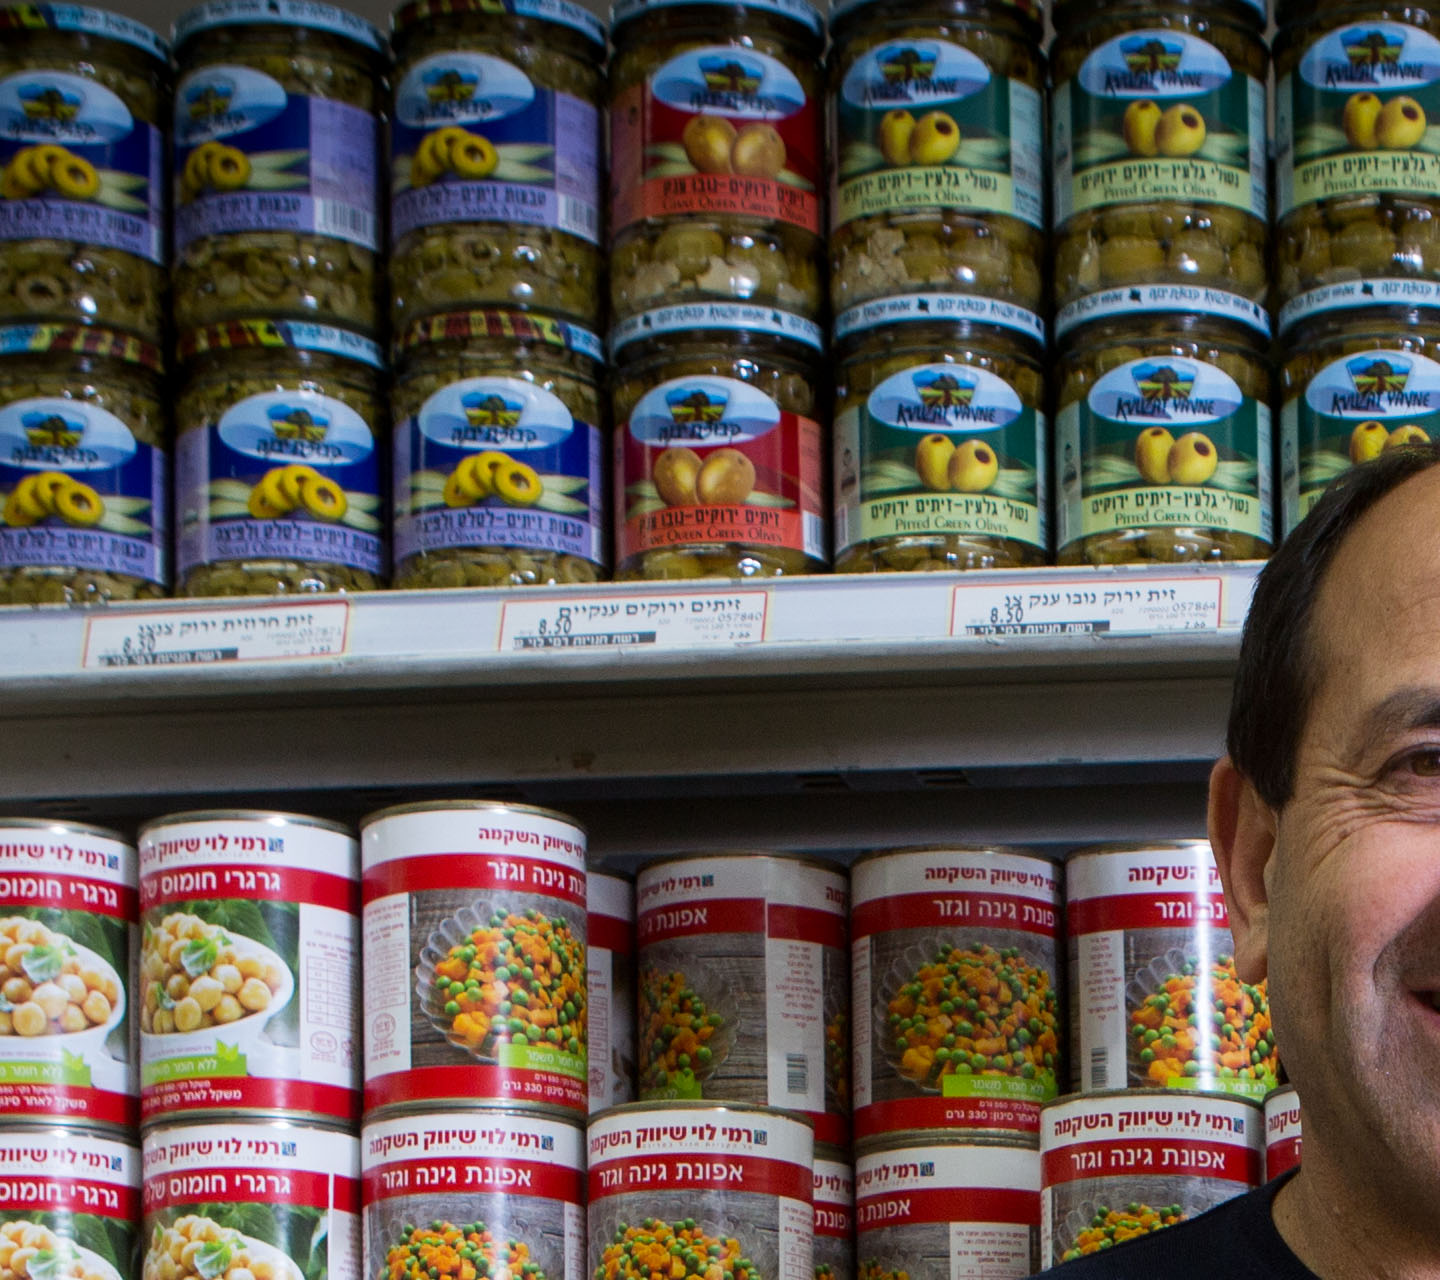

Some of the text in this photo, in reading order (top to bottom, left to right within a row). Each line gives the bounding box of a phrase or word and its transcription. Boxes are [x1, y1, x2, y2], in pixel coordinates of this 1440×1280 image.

[51, 845, 75, 862] לוי
[77, 851, 107, 867] רמי
[70, 882, 118, 909] גרגרי
[599, 1161, 744, 1185] אפונת גינה וגזר
